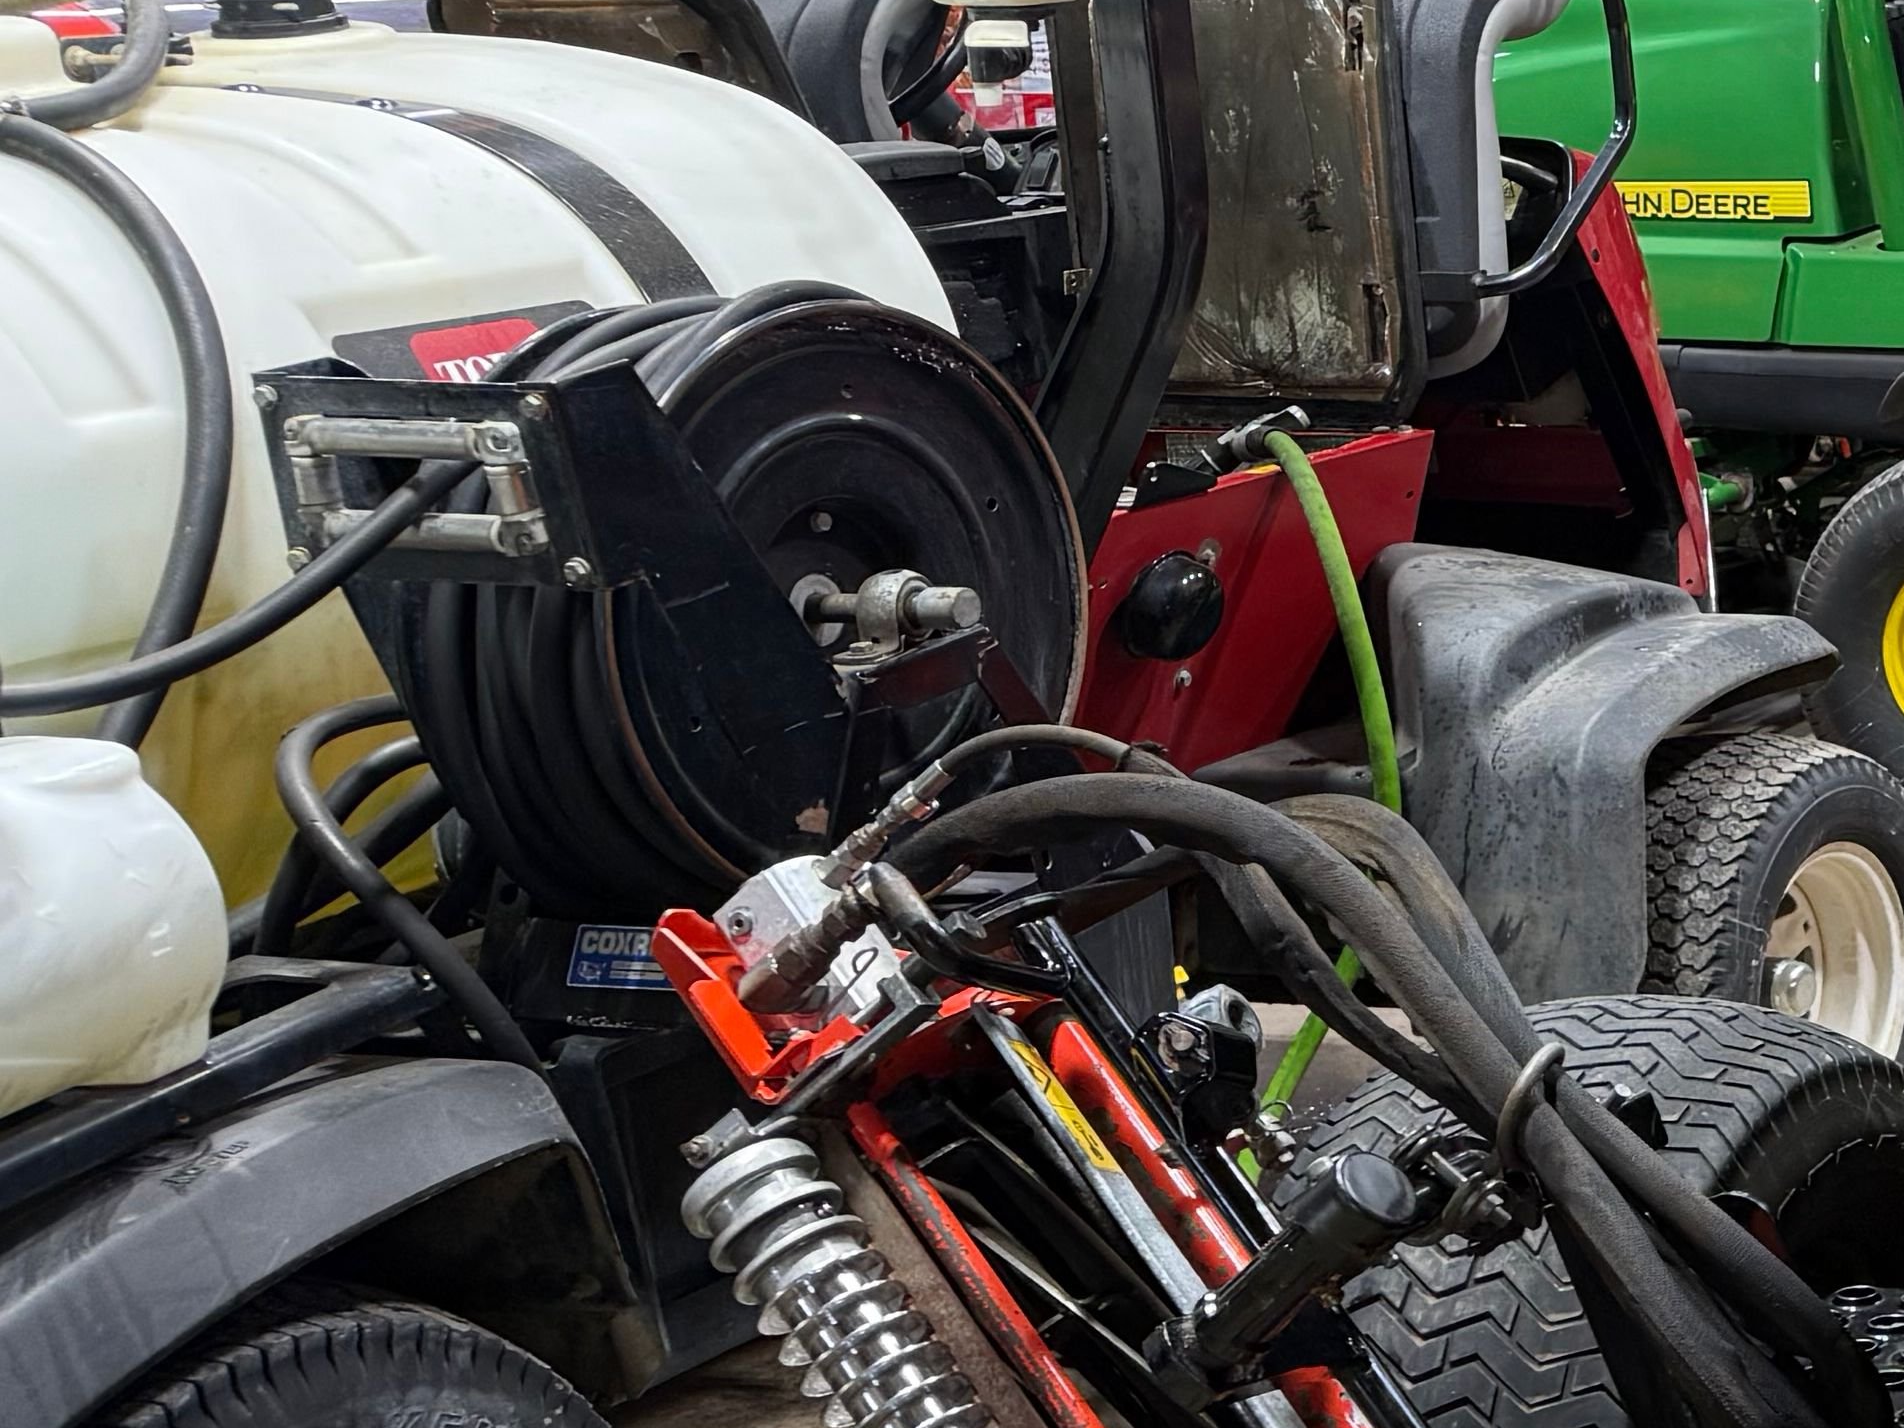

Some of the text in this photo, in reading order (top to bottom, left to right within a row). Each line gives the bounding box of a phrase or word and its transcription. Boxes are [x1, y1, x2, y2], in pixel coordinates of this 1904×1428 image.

[1622, 189, 1771, 215] HN DEERE
[581, 930, 653, 956] COXR
